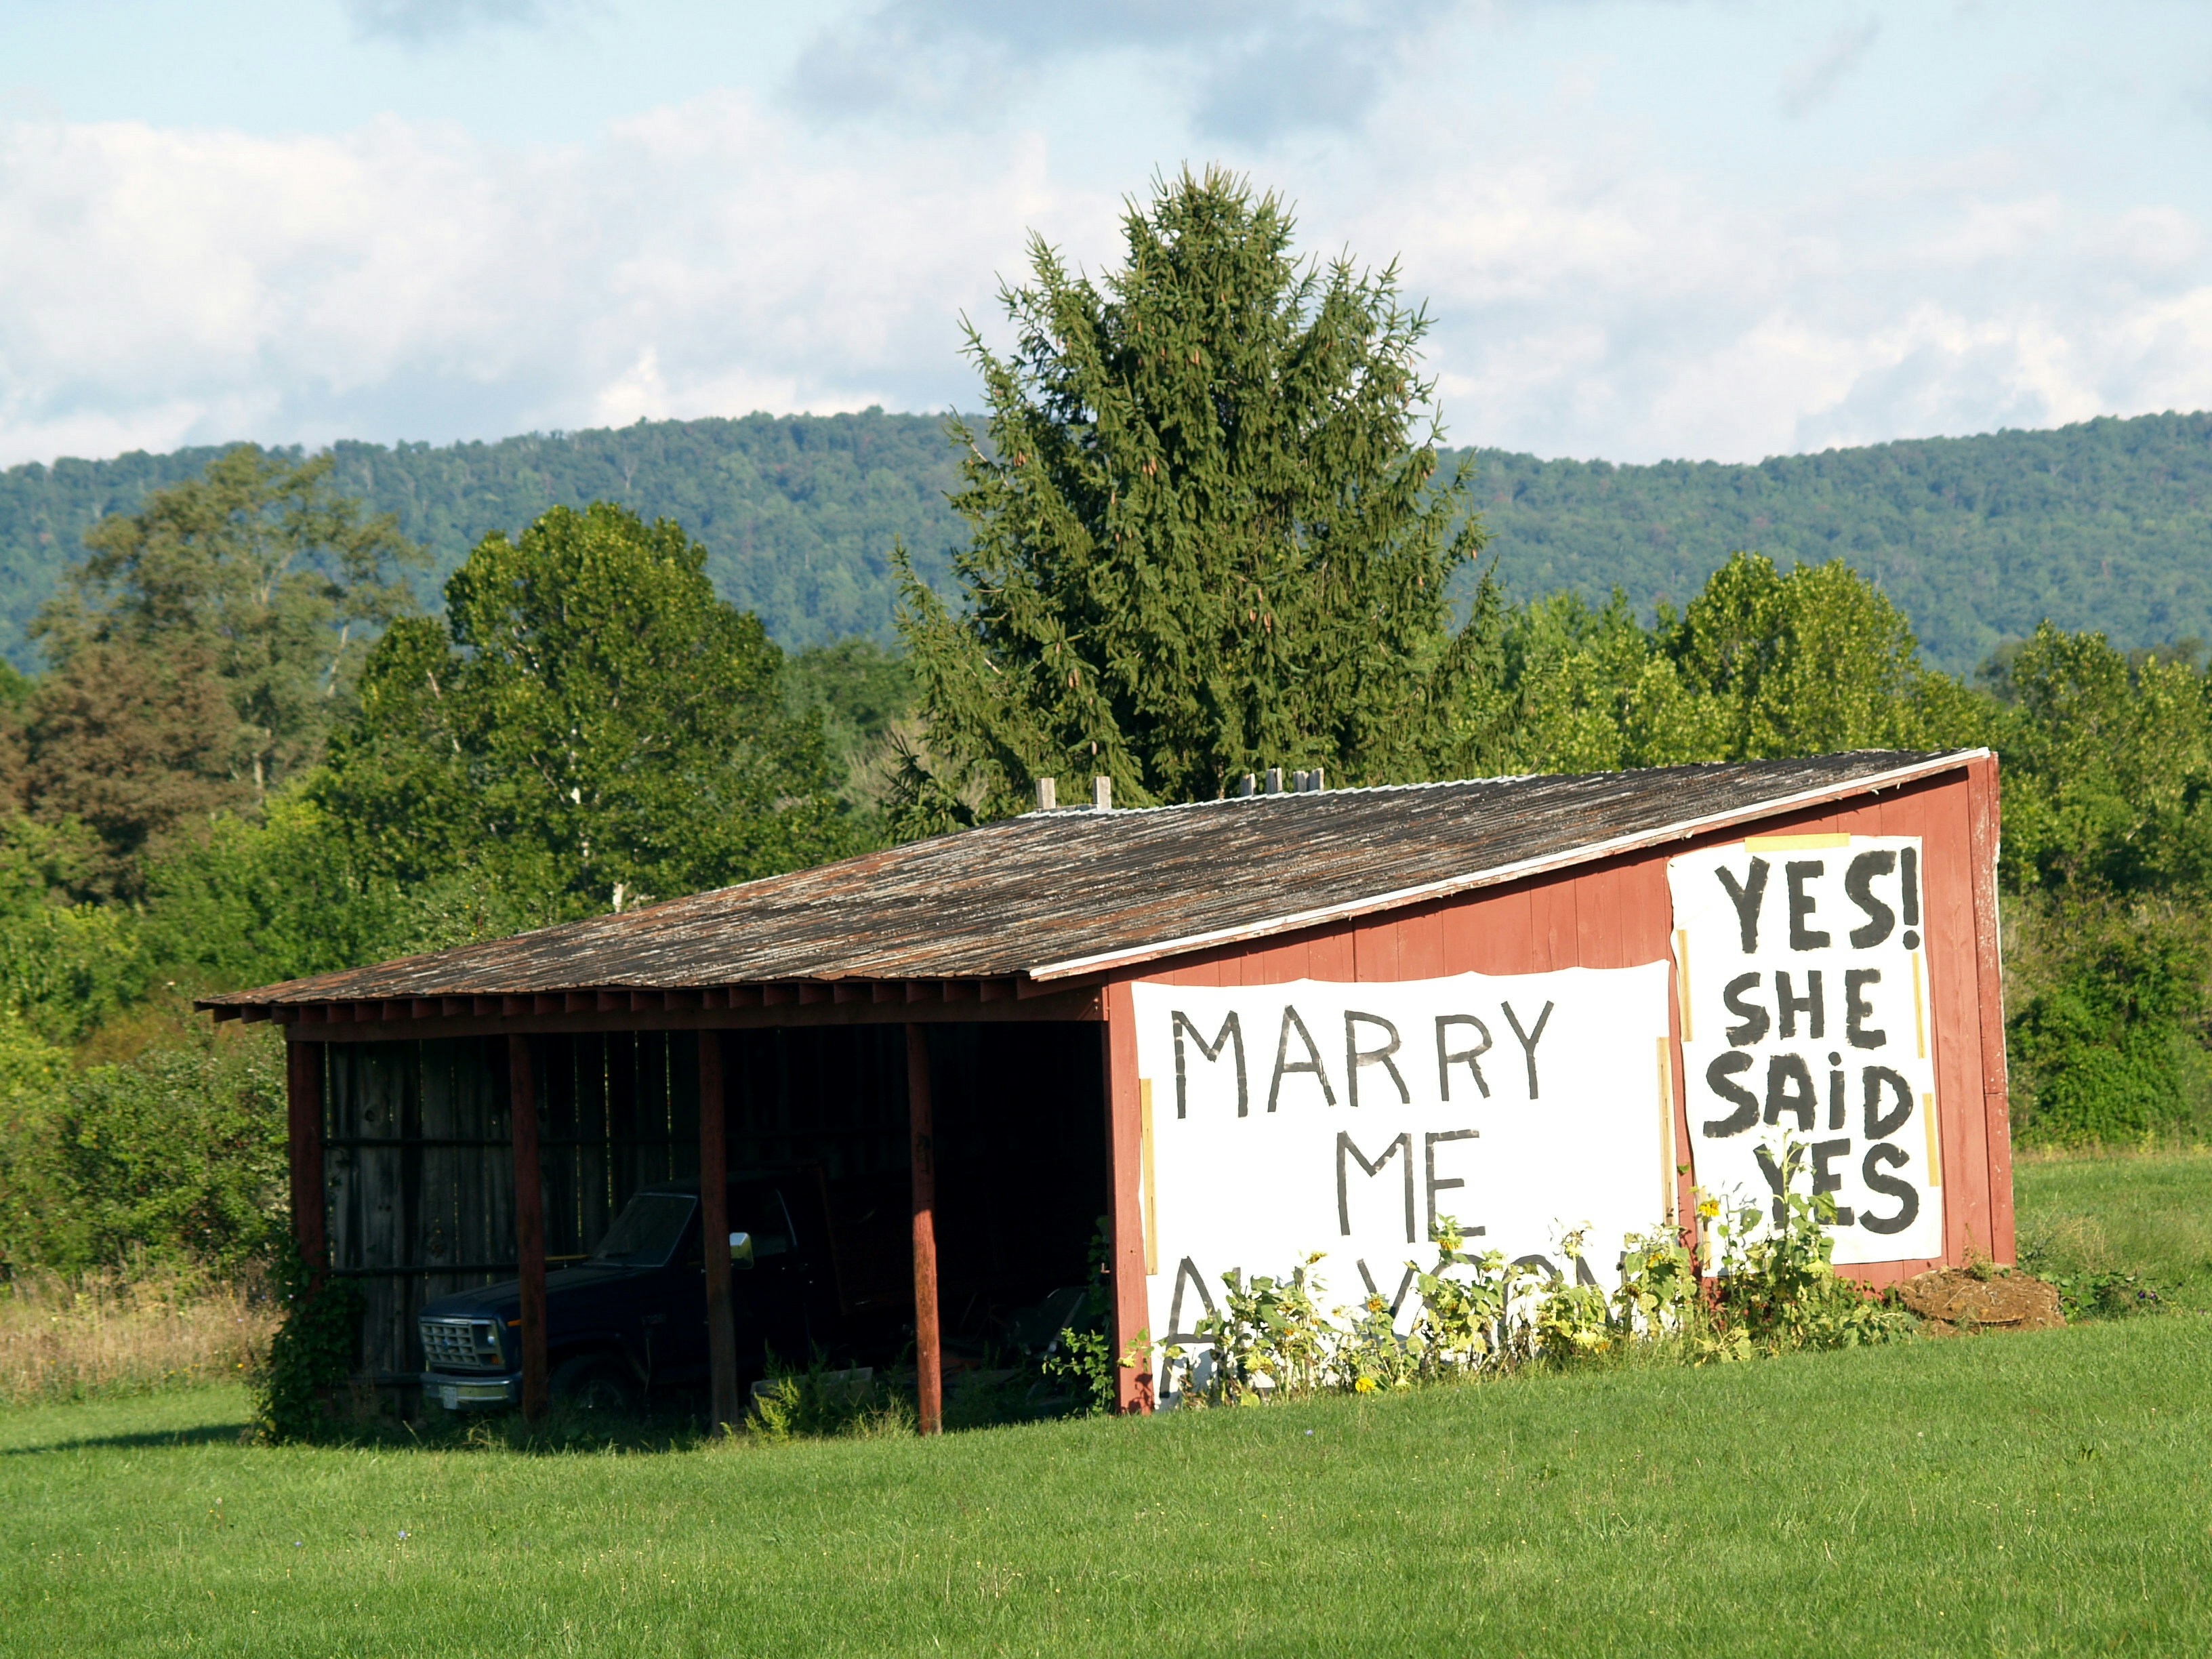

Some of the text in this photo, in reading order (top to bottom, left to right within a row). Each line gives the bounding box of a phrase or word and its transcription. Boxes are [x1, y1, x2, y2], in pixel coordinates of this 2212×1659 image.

[1714, 846, 1921, 954] YES!
[1170, 1000, 1555, 1120] MARRY
[1723, 968, 1887, 1050] SHE
[1336, 1129, 1487, 1244] ME
[1753, 1139, 1921, 1235] YES
